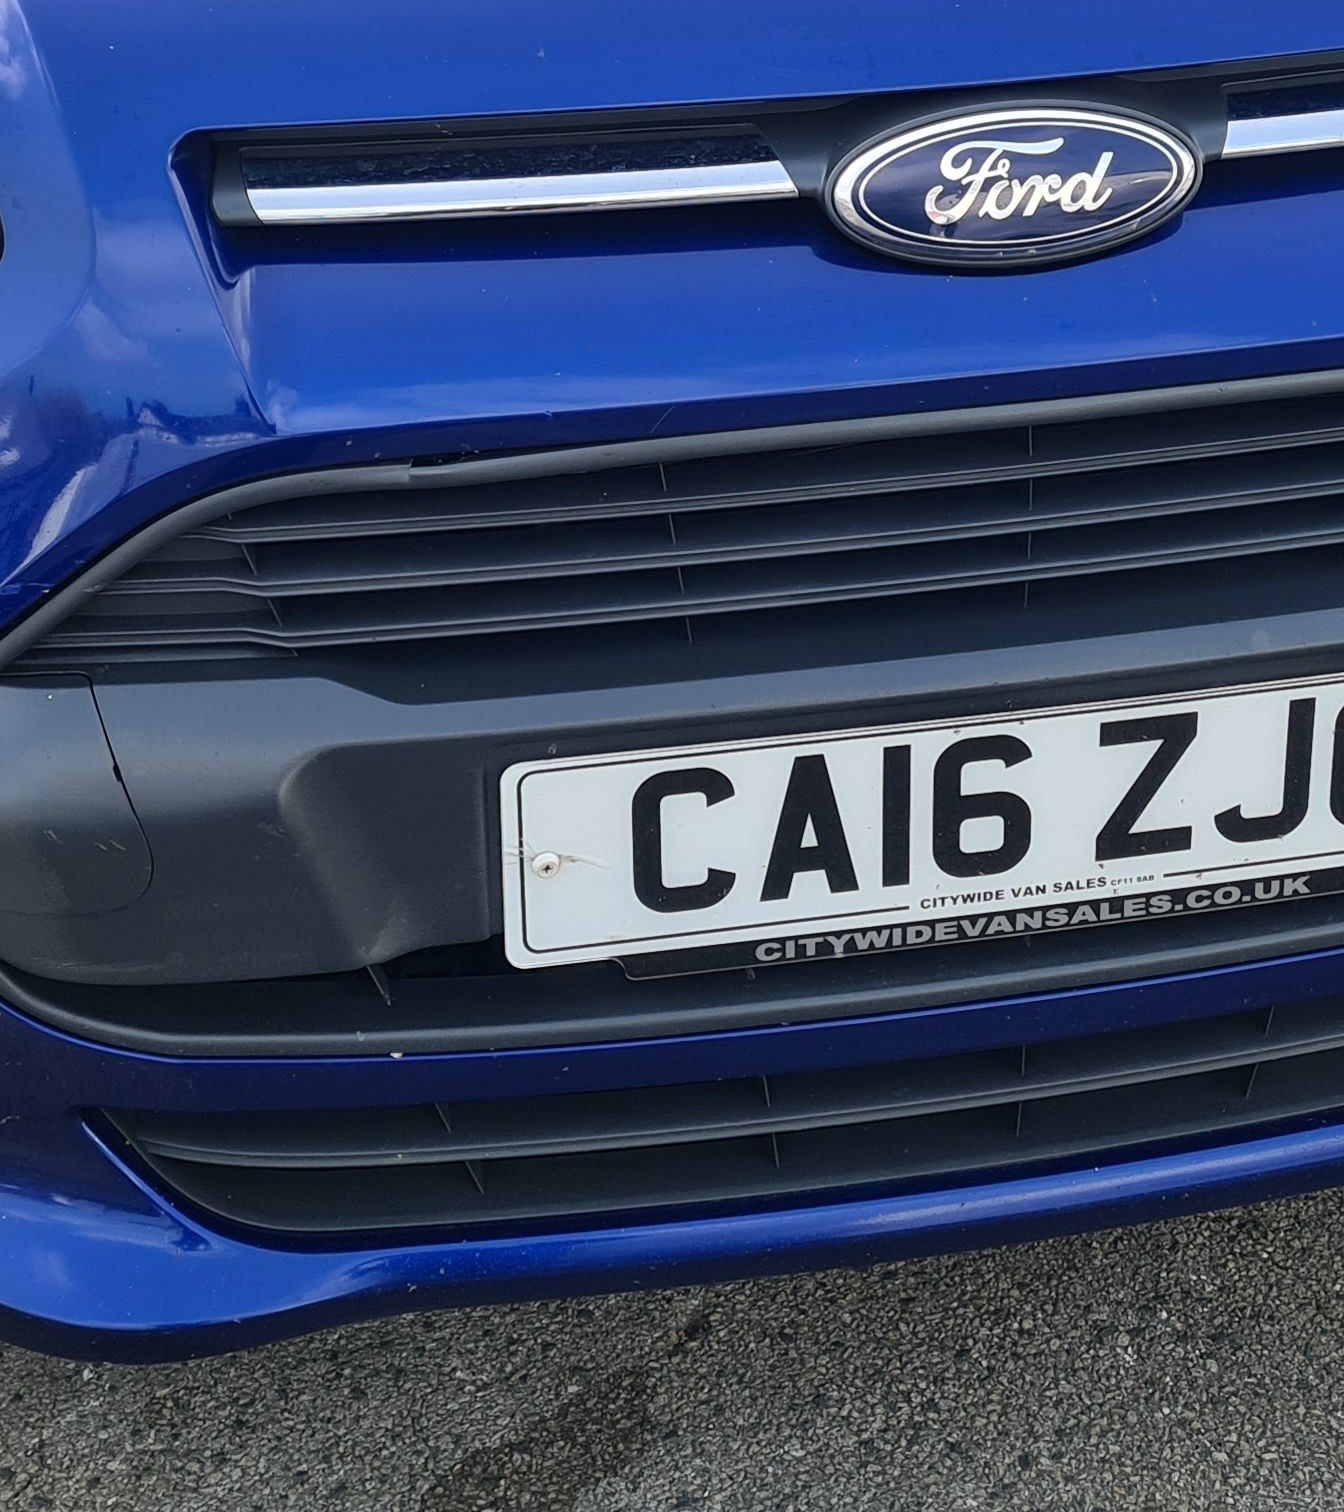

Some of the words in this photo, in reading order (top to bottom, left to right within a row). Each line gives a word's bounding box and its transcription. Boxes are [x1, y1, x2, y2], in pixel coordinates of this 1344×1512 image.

[924, 137, 1114, 225] Ford
[630, 732, 1033, 914] CA16
[755, 875, 1311, 963] CITYWIDEVANSALES.CO.UK
[920, 889, 1006, 909] CITYWIDE
[1011, 884, 1047, 898] VAN
[1052, 876, 1107, 893] SALES
